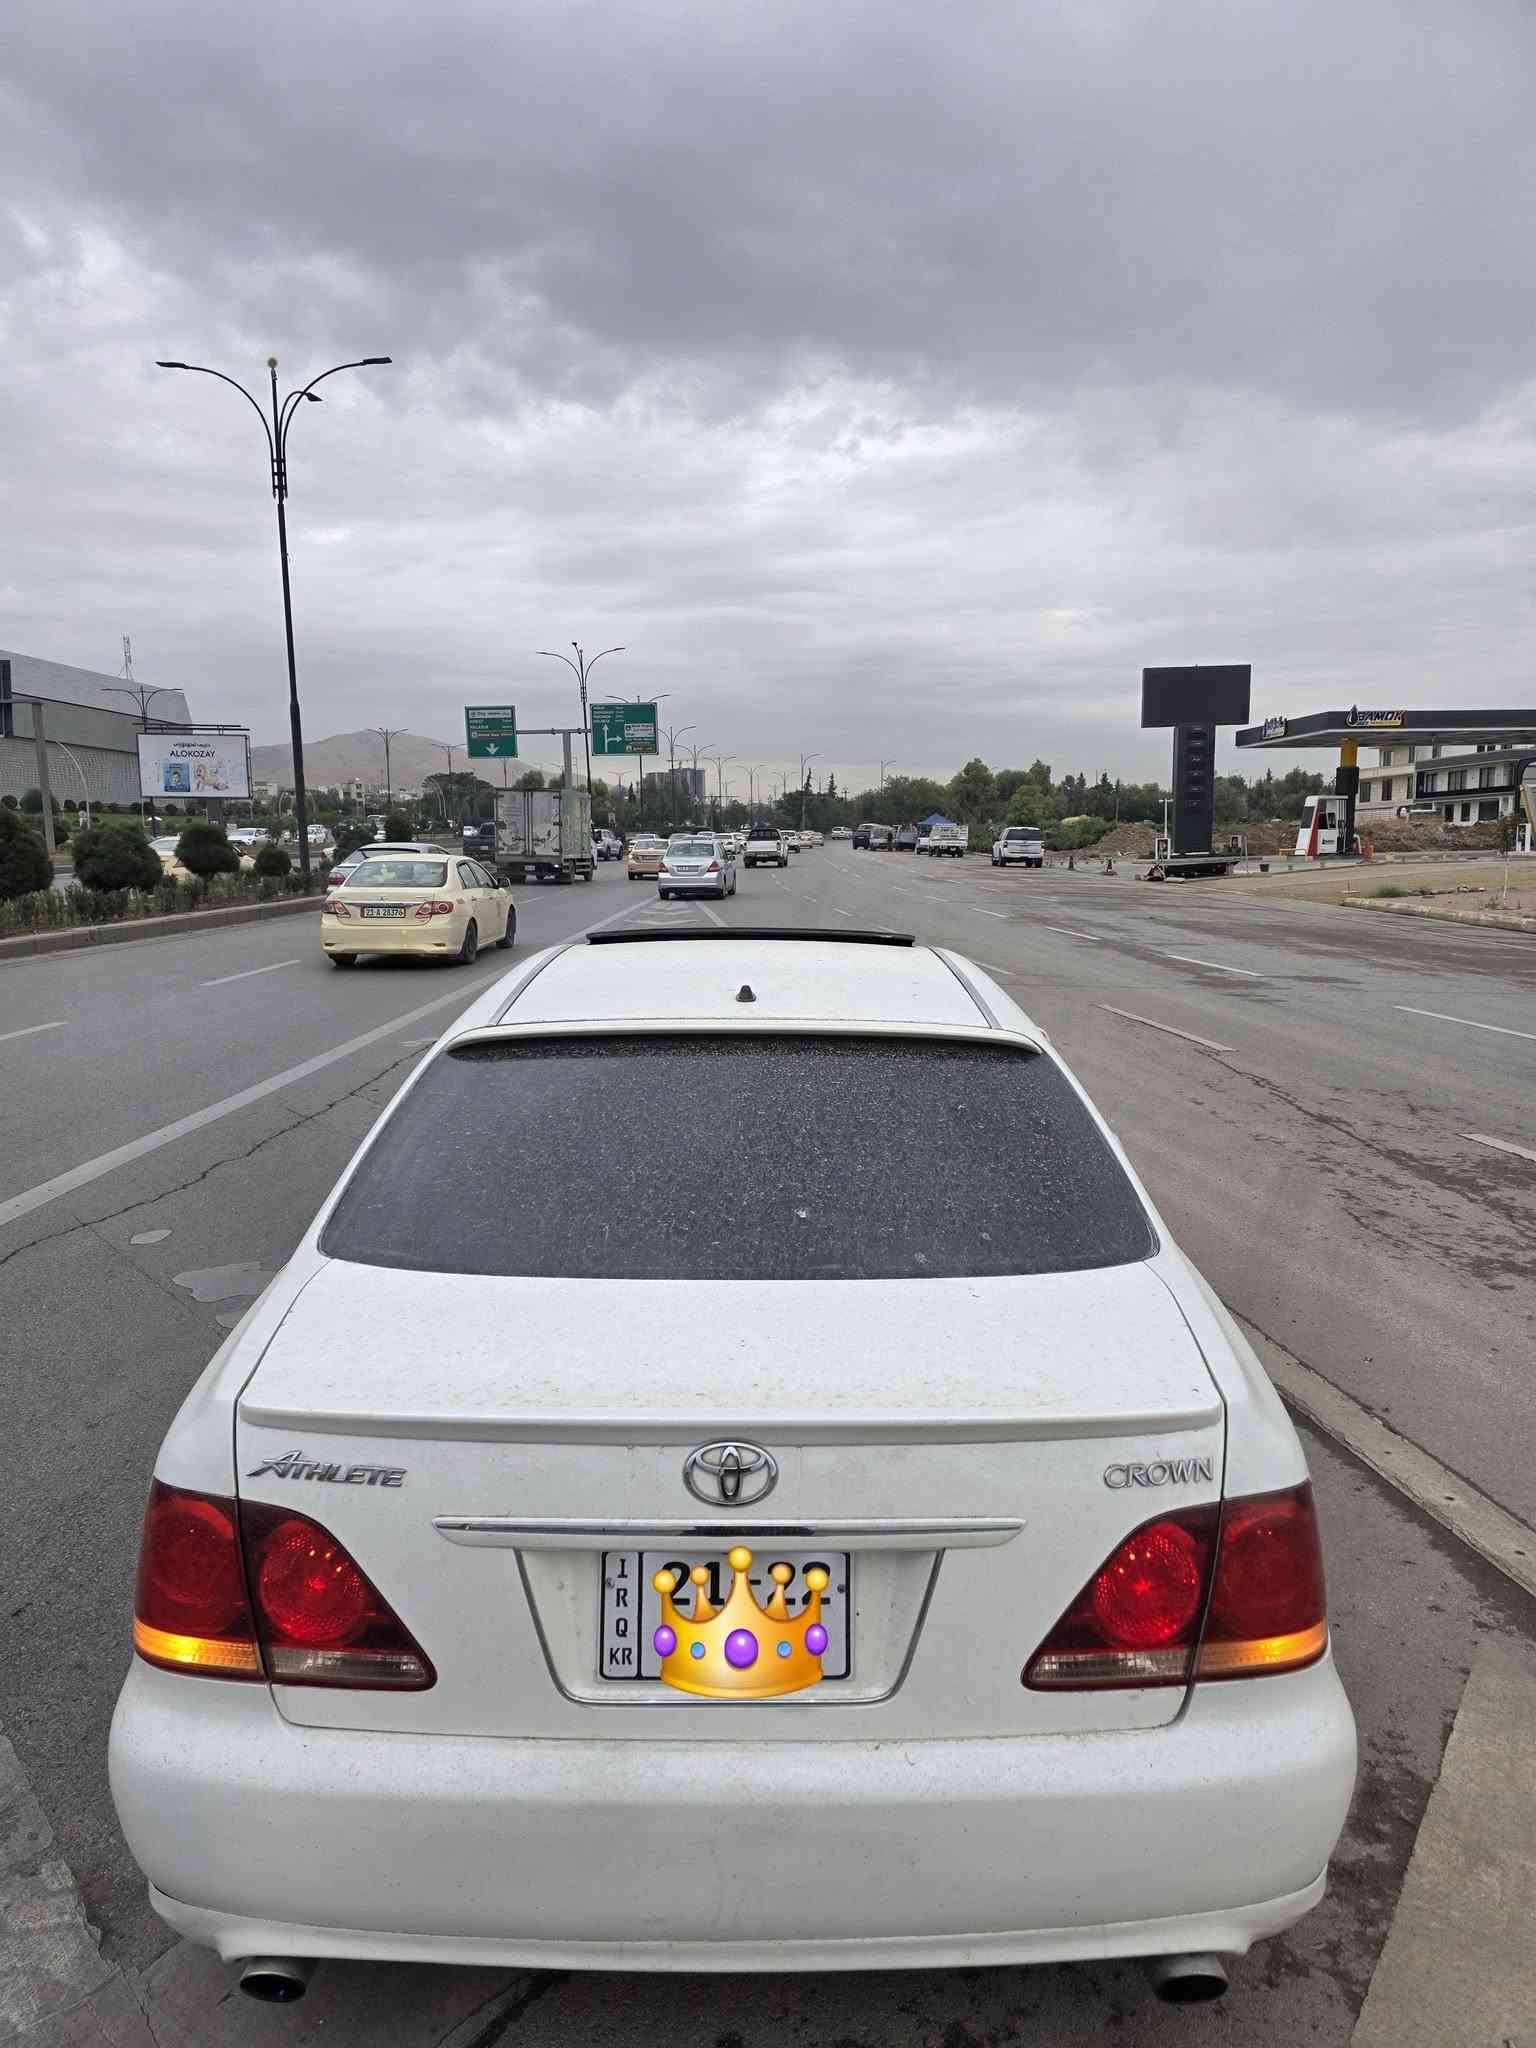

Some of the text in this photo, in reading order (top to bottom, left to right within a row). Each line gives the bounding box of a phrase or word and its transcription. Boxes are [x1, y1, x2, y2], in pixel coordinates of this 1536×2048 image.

[169, 750, 216, 758] ALOKOZAY
[246, 1450, 408, 1488] ATHLETE
[1103, 1457, 1214, 1488] CROWN
[609, 1647, 632, 1665] KR
